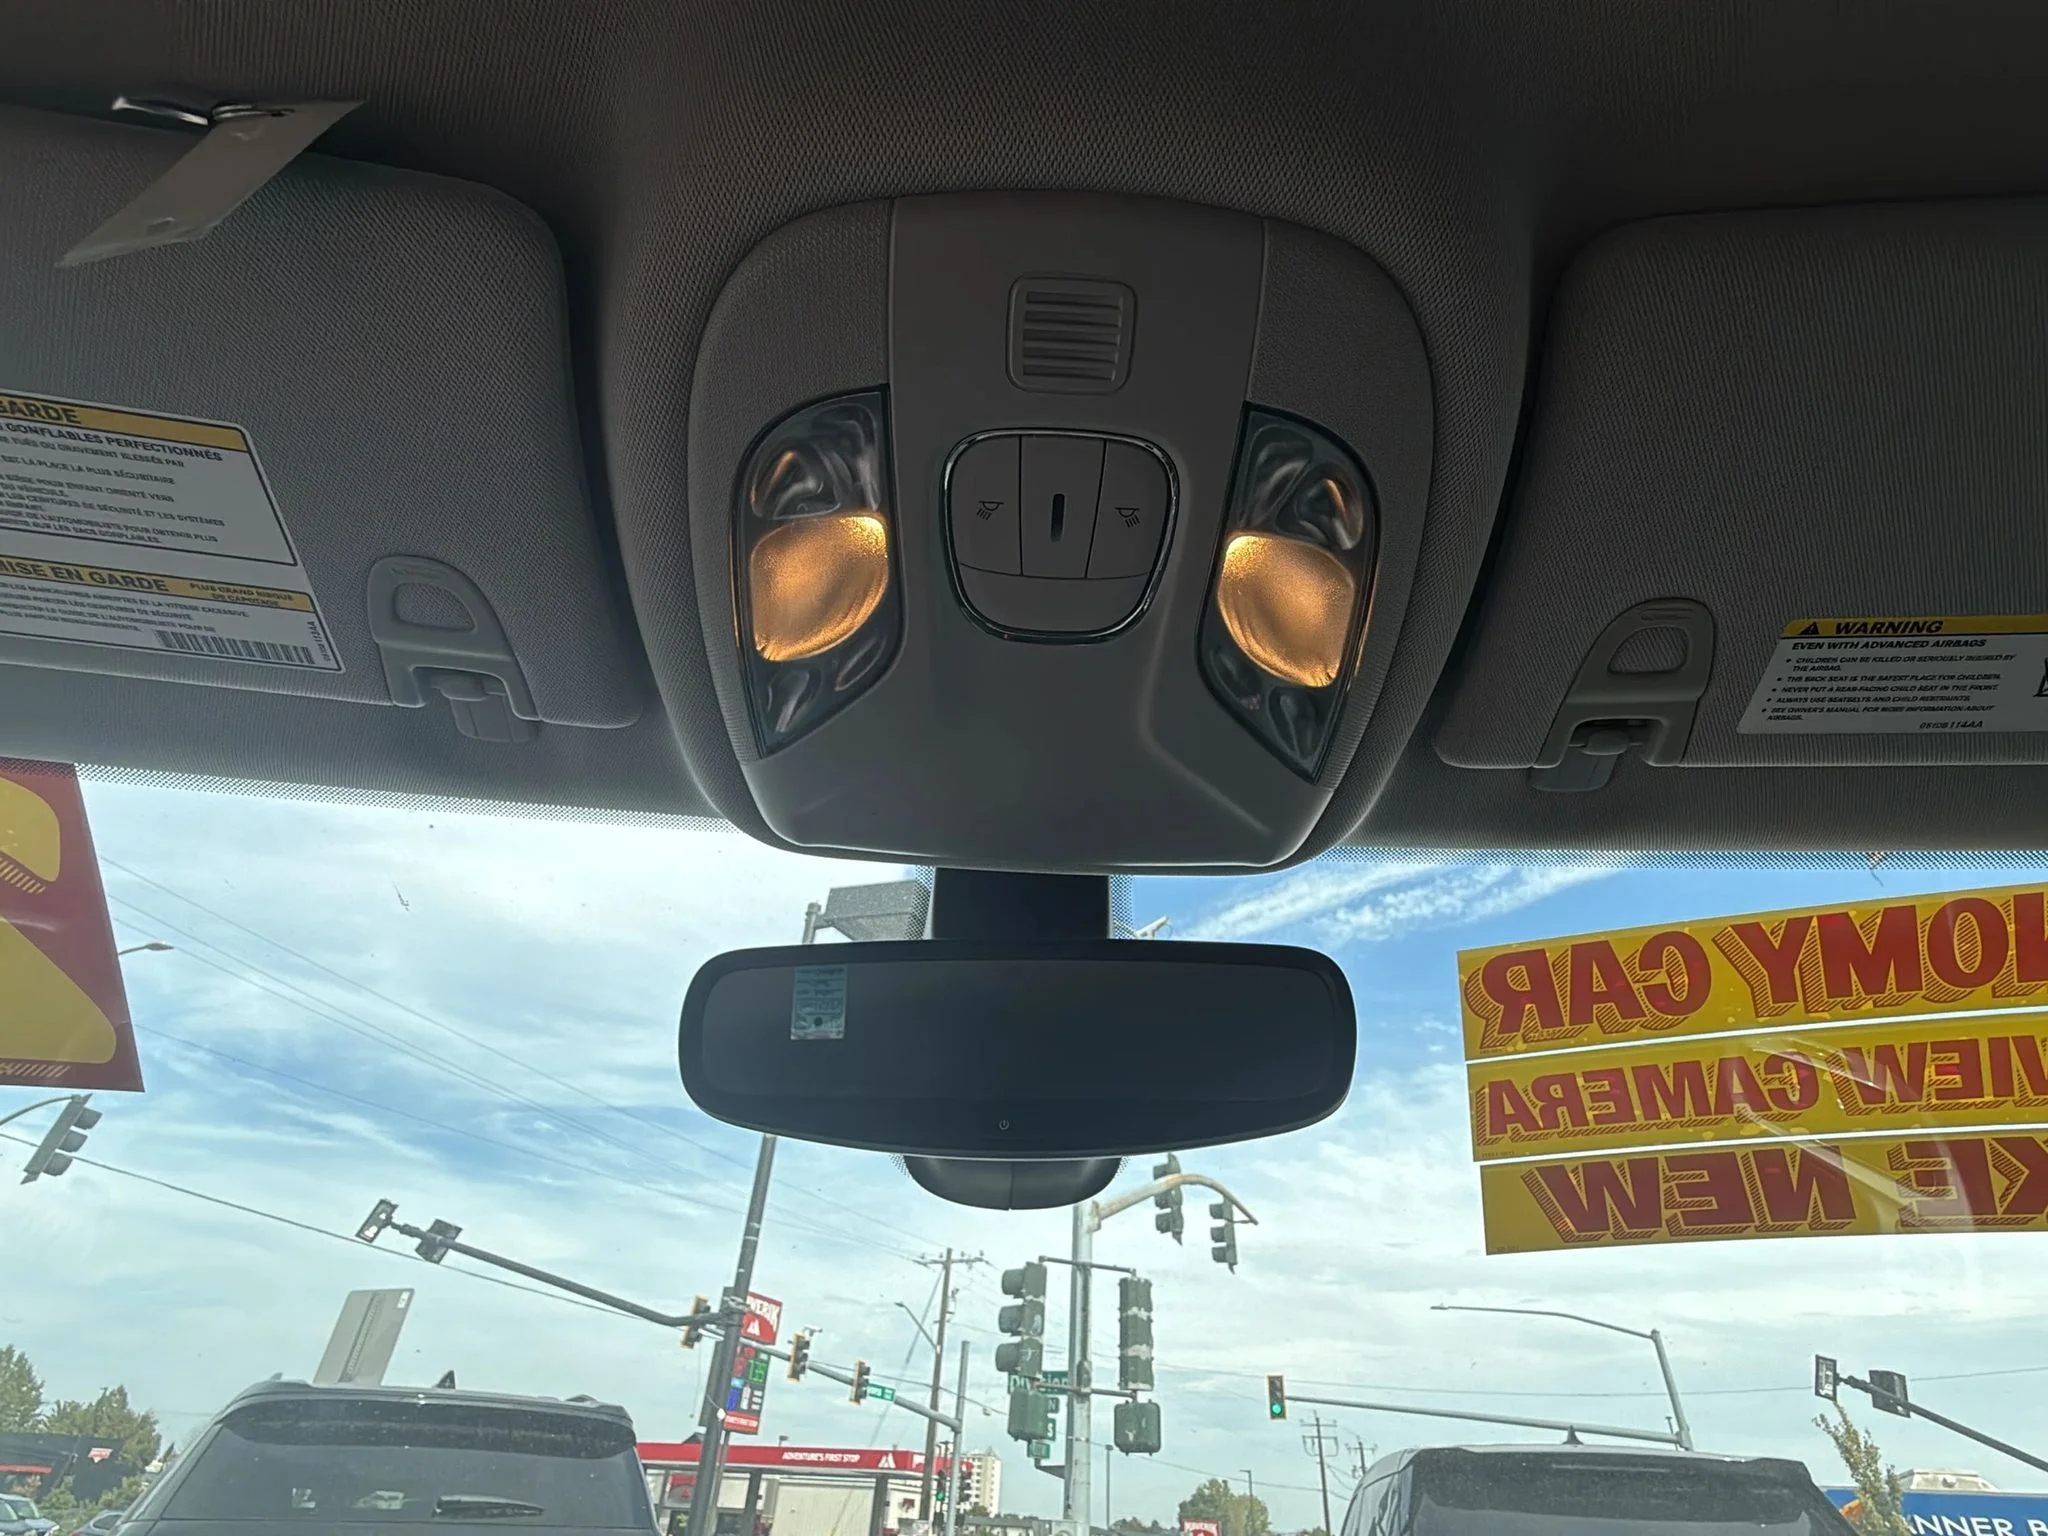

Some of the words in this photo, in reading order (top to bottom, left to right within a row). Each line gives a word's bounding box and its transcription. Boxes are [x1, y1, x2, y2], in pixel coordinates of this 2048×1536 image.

[5, 423, 102, 444] GONFLABLES
[104, 436, 223, 460] PERFECTIONNÉS
[49, 565, 84, 582] EN
[88, 571, 169, 592] GARDE
[1834, 620, 1944, 635] WARNING
[1791, 642, 1825, 650] EVEN
[1825, 641, 1860, 649] WITH
[1859, 639, 1930, 648] ADVANCED
[1930, 638, 1988, 647] AIRBAGS
